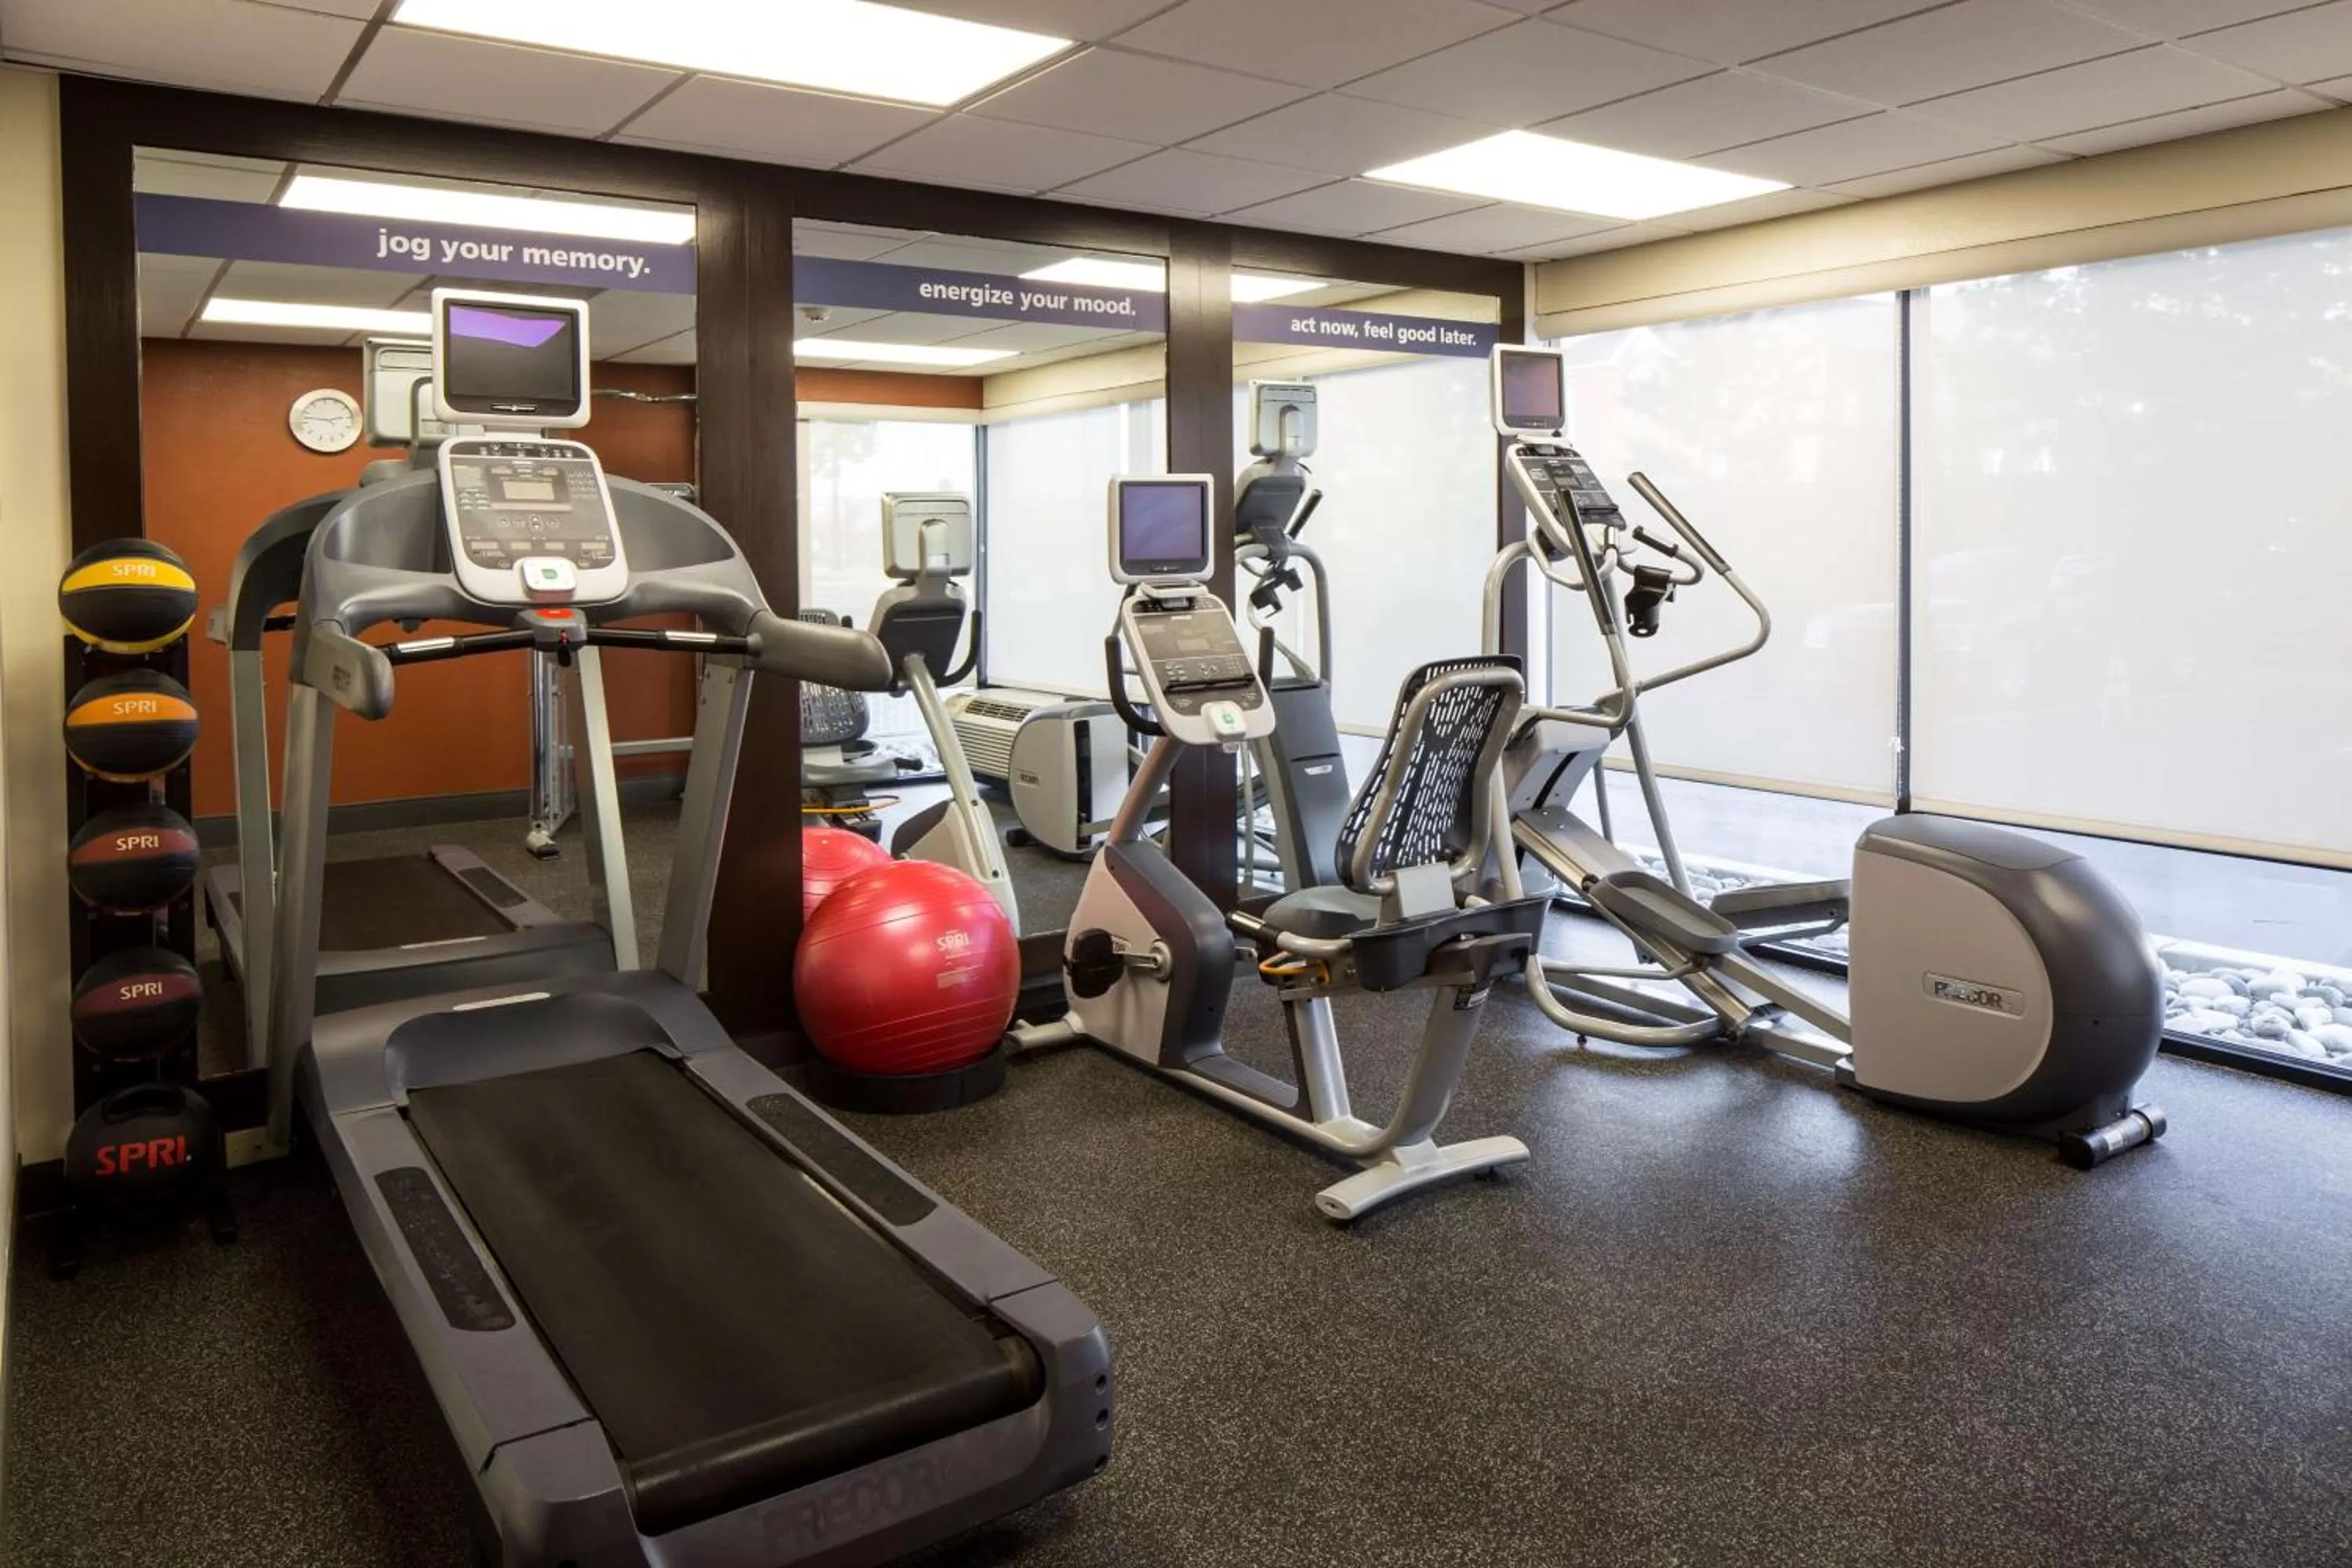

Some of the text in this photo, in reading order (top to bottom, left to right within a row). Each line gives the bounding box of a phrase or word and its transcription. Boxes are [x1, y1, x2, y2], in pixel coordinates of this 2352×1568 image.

[377, 228, 651, 278] jog your memory.
[920, 282, 1136, 316] energize your mood.
[1291, 318, 1476, 346] act now, feel good later.
[112, 564, 156, 578] SPRI
[113, 699, 157, 715] SPRI
[115, 835, 159, 851] SPRI
[120, 982, 162, 1000] SPRI
